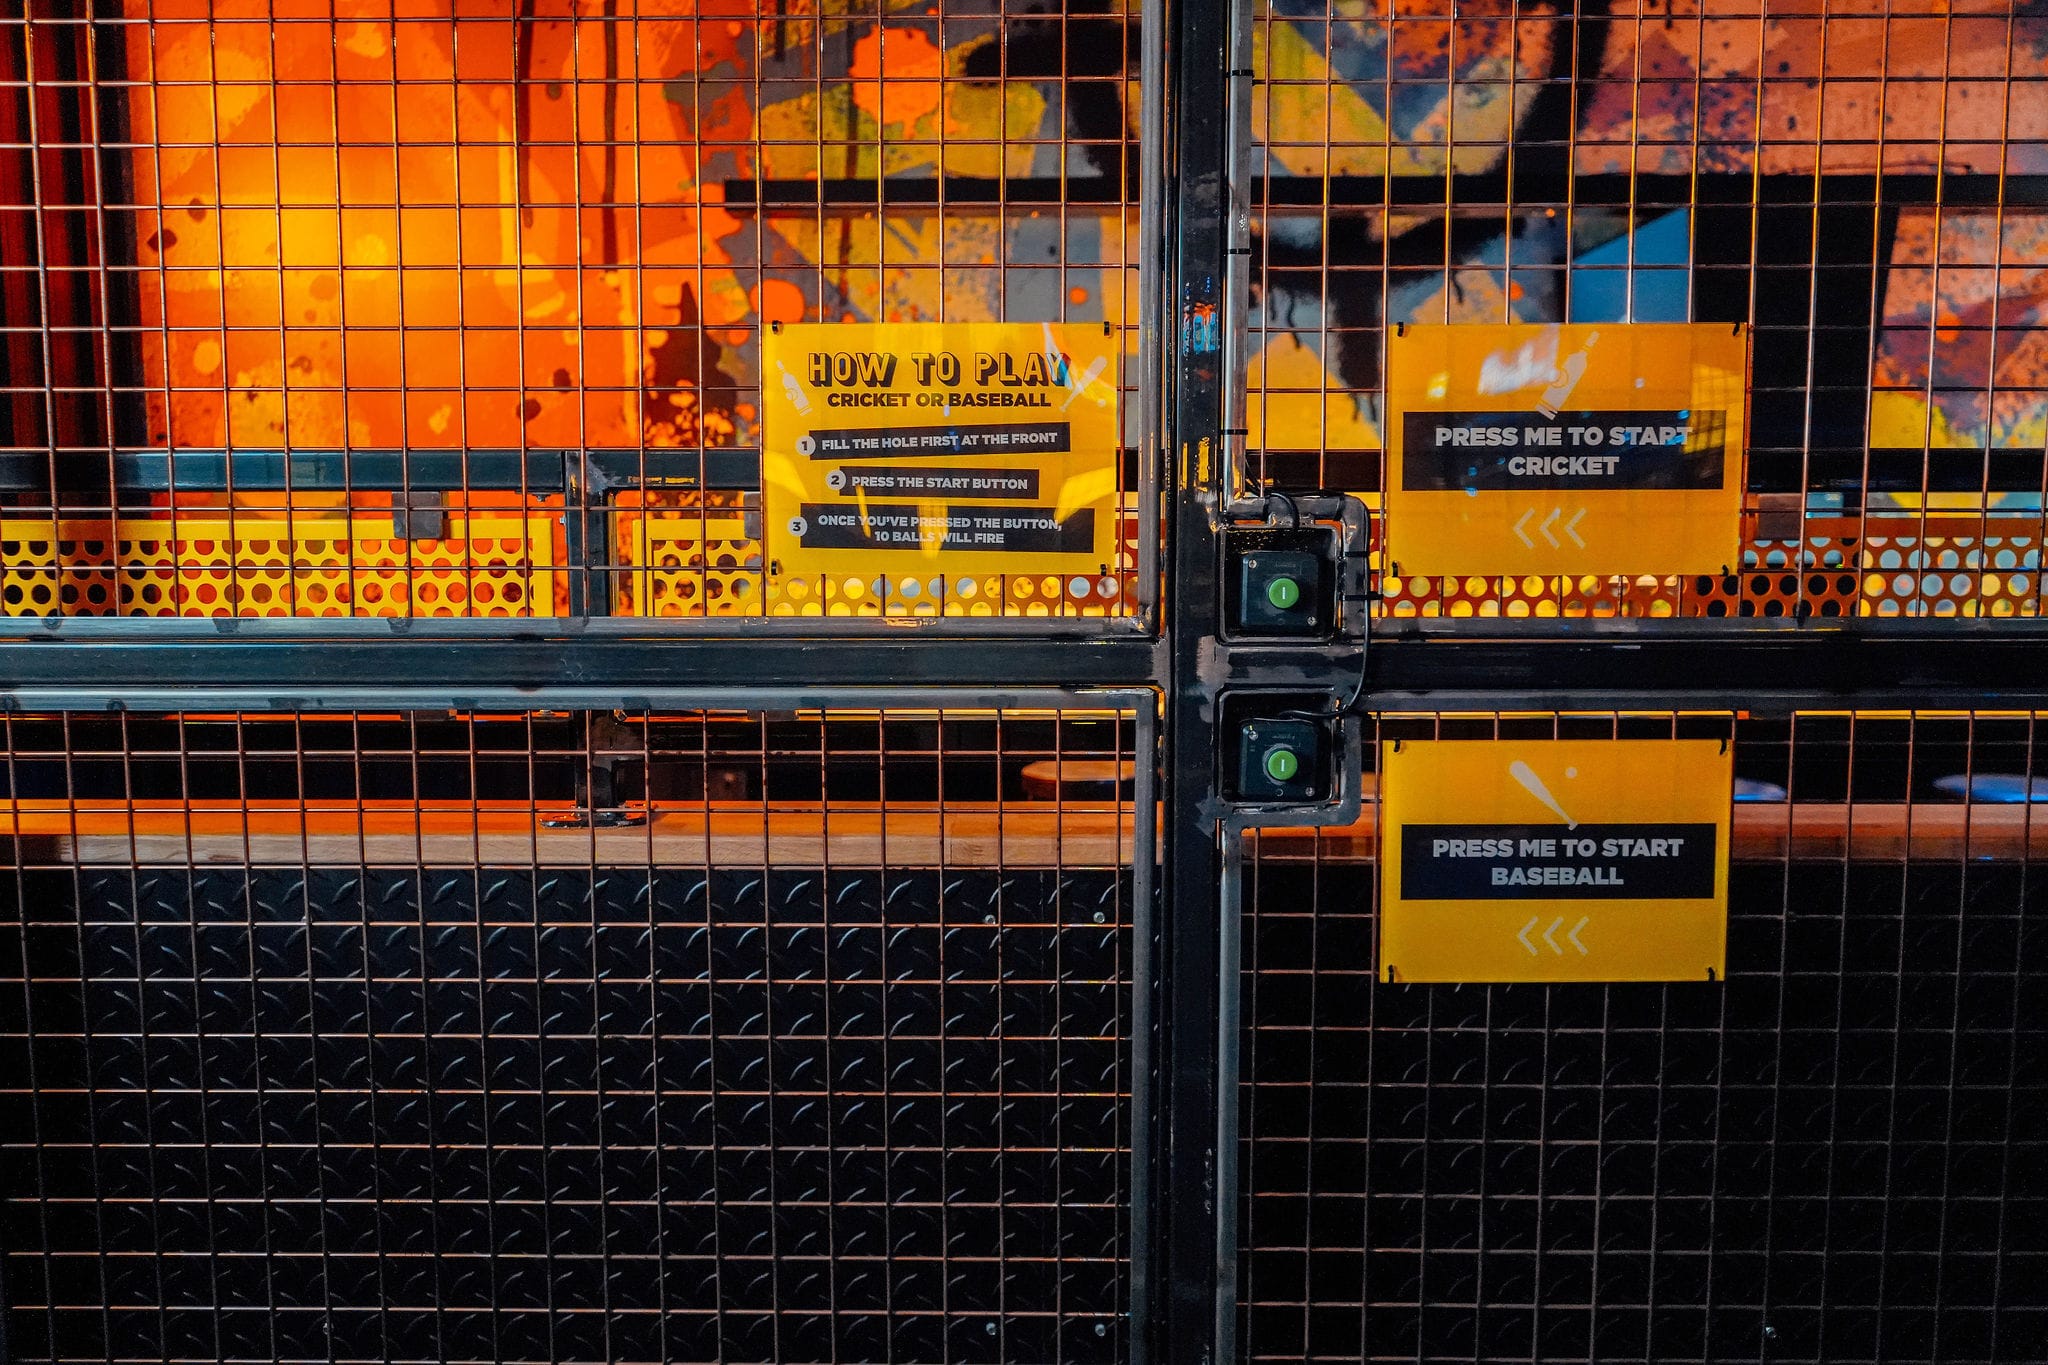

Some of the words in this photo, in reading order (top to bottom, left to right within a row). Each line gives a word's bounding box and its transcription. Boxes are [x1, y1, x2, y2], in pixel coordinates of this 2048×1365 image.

[808, 352, 897, 387] HOW
[912, 352, 960, 387] TO
[975, 352, 1072, 387] PLAY
[827, 393, 910, 407] CRICKET
[915, 393, 944, 407] OR
[948, 393, 1051, 407] BASEBALL
[822, 439, 850, 450] FILL
[853, 438, 879, 449] THE
[882, 436, 918, 448] HOLE
[921, 435, 958, 447] FIRST
[961, 434, 980, 445] AT
[982, 434, 1009, 445] THE
[1012, 432, 1057, 444] FRONT
[1436, 427, 1519, 446] PRESS
[1524, 427, 1562, 446] ME
[1568, 427, 1603, 446] TO
[1609, 426, 1693, 445] START
[1508, 456, 1620, 475] CRICKET
[852, 477, 894, 488] PRESS
[897, 477, 924, 488] THE
[927, 477, 969, 489] START
[973, 478, 1028, 490] BUTTON
[818, 515, 855, 526] ONCE
[858, 516, 908, 527] YOU'VE
[911, 517, 970, 529] PRESSED
[974, 518, 1000, 529] THE
[1003, 518, 1062, 531] BUTTON,
[875, 531, 889, 542] 10
[893, 531, 936, 542] BALLS
[939, 532, 971, 543] WILL
[975, 532, 1004, 544] FIRE
[1433, 839, 1514, 857] PRESS
[1519, 839, 1556, 857] ME
[1562, 839, 1597, 856] TO
[1602, 839, 1684, 856] START
[1491, 867, 1624, 885] BASEBALL
